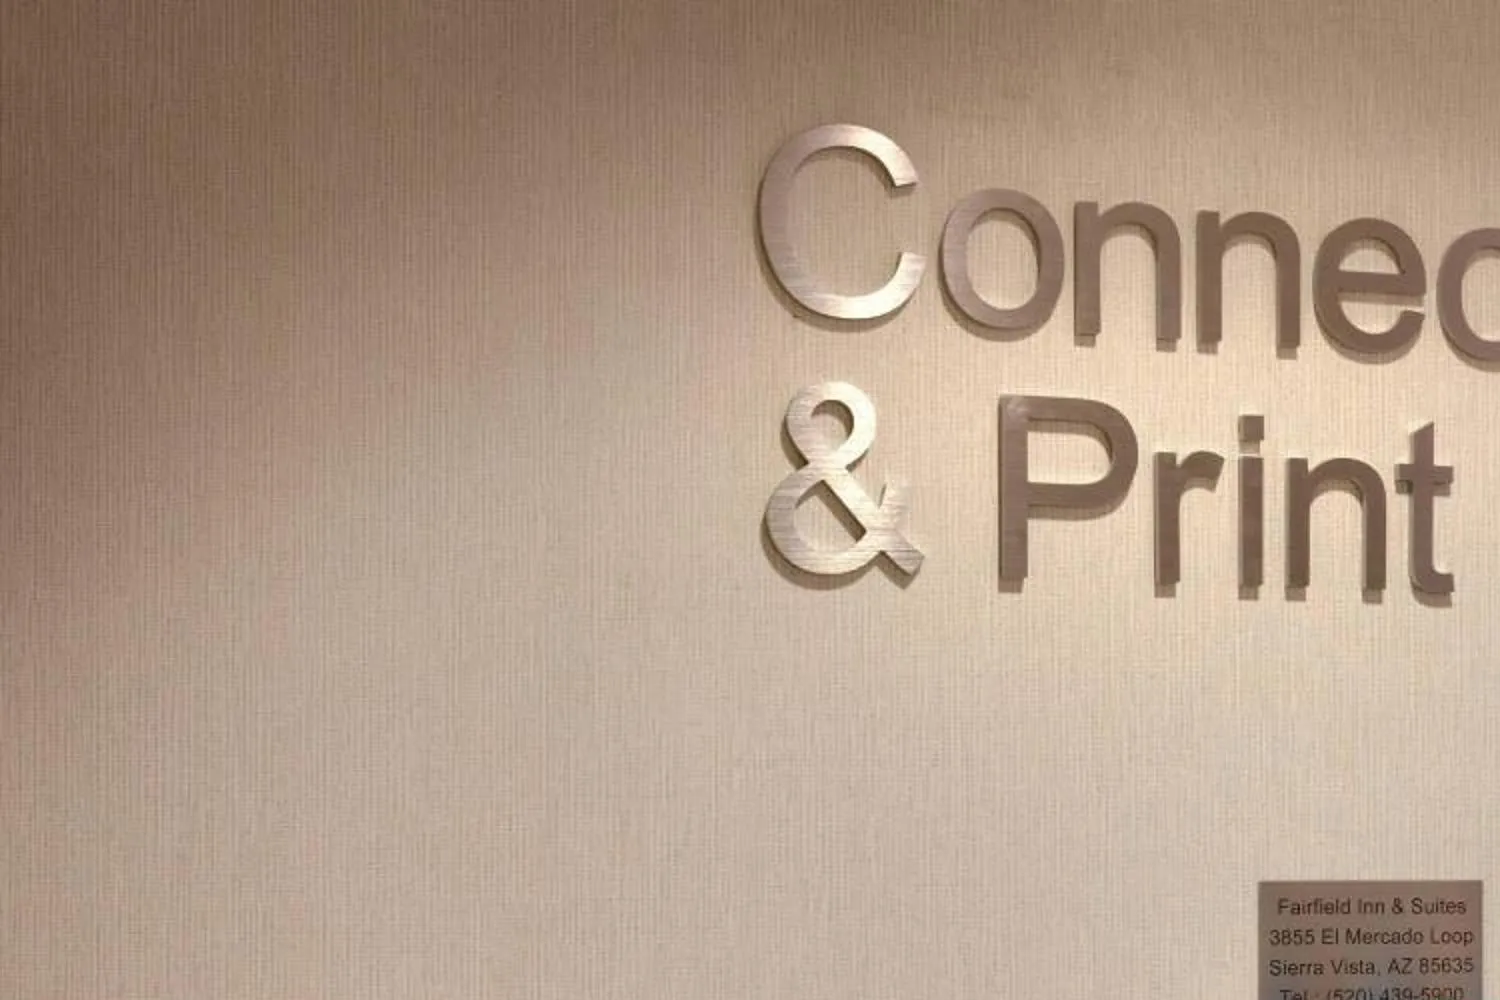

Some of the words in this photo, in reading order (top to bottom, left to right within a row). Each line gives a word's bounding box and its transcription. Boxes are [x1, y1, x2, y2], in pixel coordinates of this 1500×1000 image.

[762, 381, 926, 577] &
[998, 394, 1455, 596] Print
[1277, 897, 1351, 915] Fairfield
[1357, 898, 1386, 914] Inn
[1391, 897, 1404, 915] &
[1411, 897, 1467, 915] Suites
[1269, 928, 1315, 946] 3855
[1320, 927, 1339, 945] El
[1344, 927, 1424, 945] Mercado
[1429, 927, 1475, 947] Loop
[1269, 959, 1324, 977] Sierra
[1329, 959, 1381, 977] Vista,
[1387, 957, 1413, 975] AZ
[1419, 957, 1474, 975] 85635
